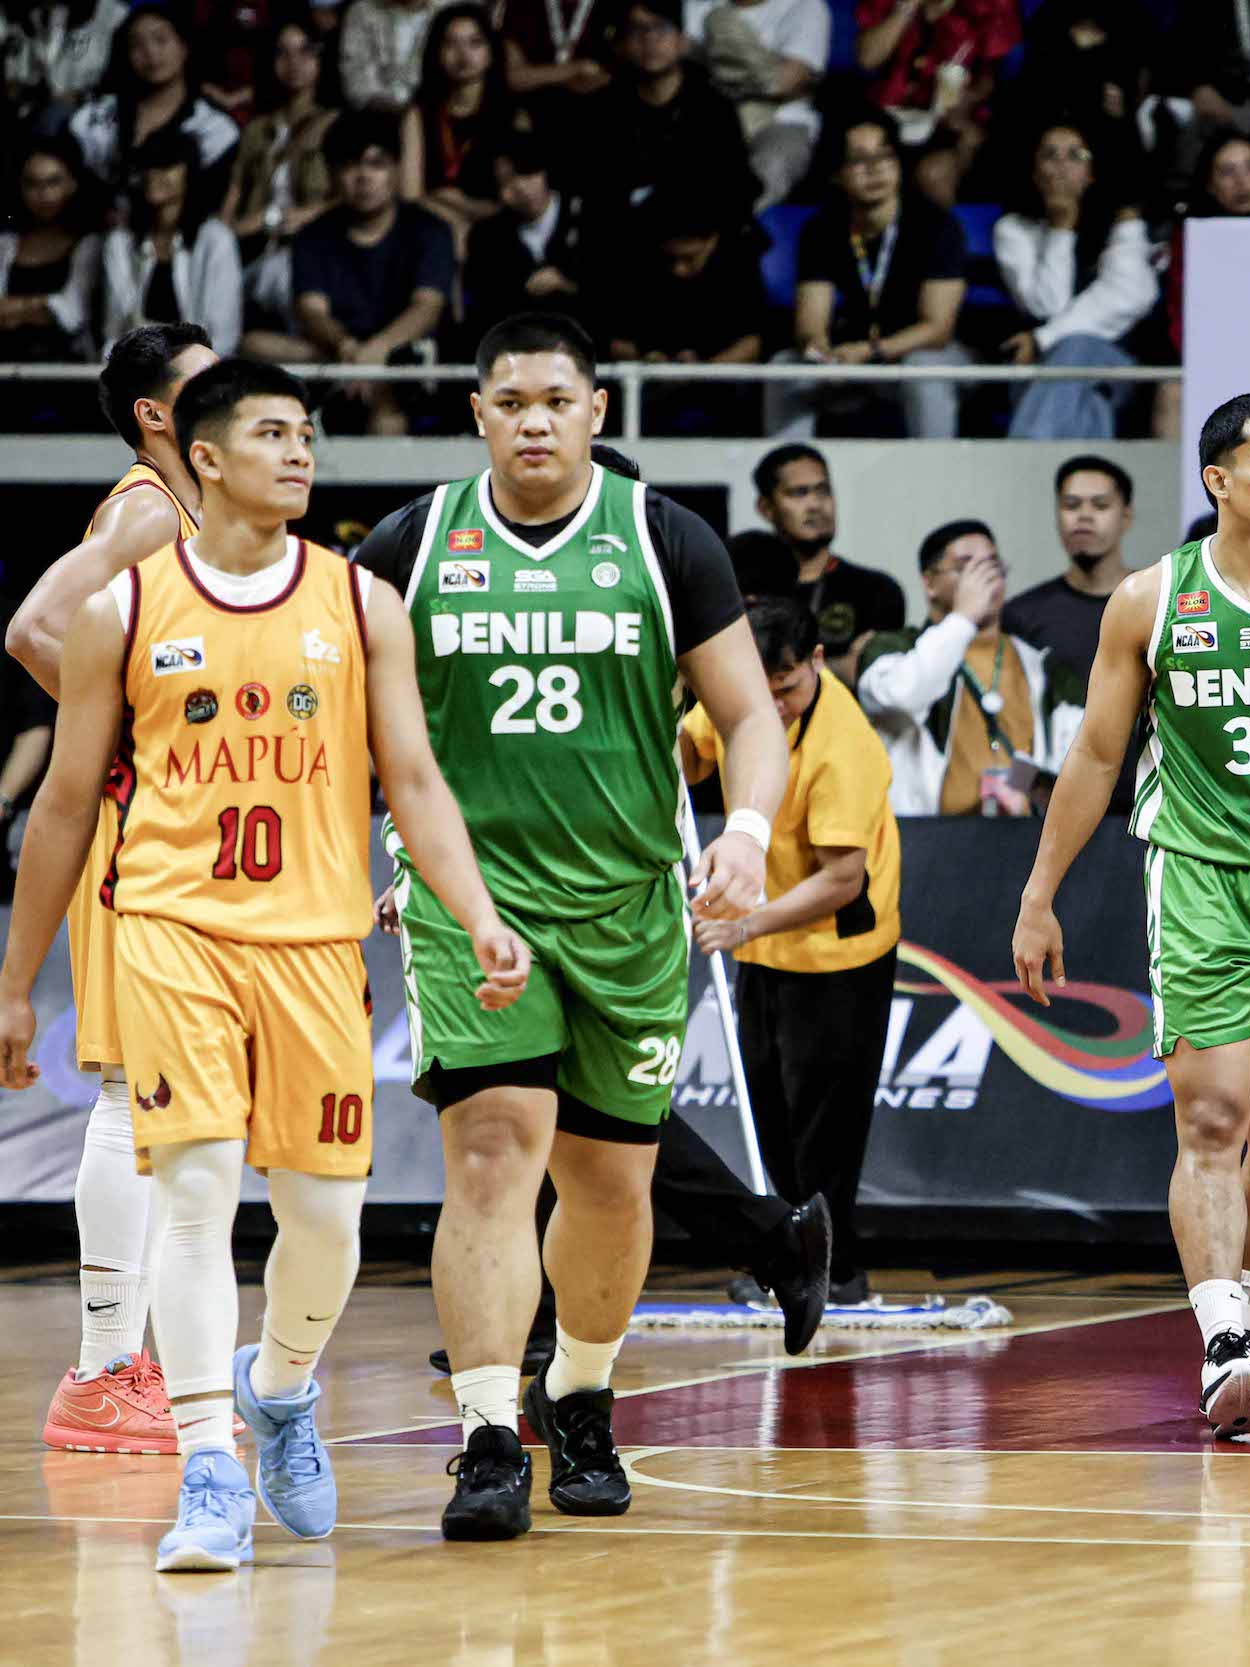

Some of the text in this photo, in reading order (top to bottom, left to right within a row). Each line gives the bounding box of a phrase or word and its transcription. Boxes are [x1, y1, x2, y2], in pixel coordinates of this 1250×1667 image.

[431, 611, 643, 657] BENILDE
[1176, 634, 1200, 647] NCAA
[155, 654, 184, 670] NCAA
[293, 694, 312, 711] DG
[488, 665, 583, 735] 28
[163, 725, 331, 789] MAPÚA
[212, 806, 282, 881] 10
[628, 1037, 679, 1086] 28
[318, 1093, 362, 1144] 10
